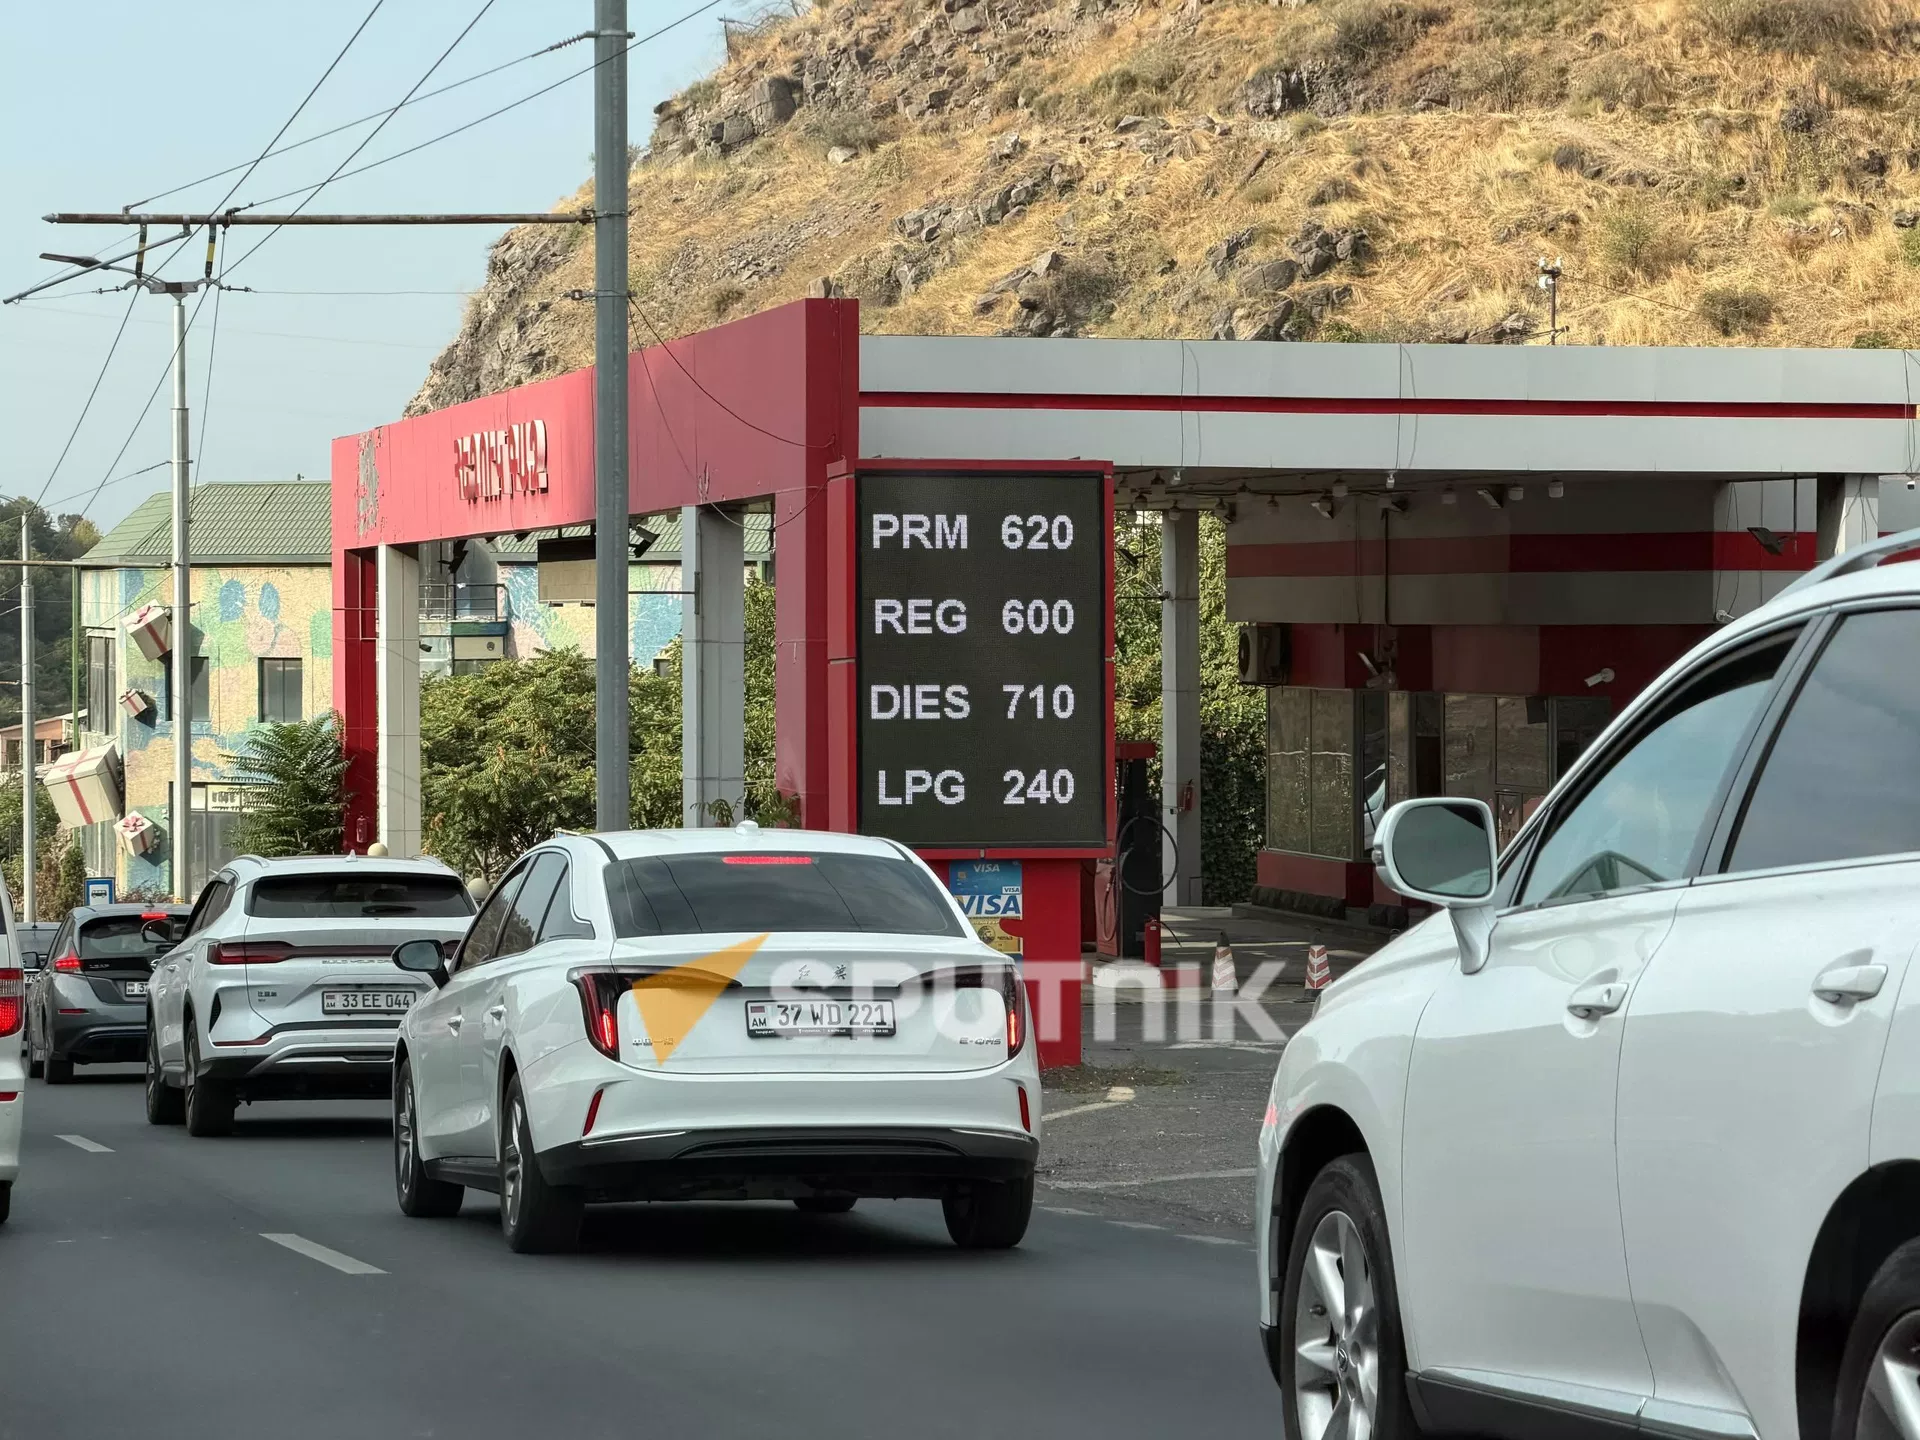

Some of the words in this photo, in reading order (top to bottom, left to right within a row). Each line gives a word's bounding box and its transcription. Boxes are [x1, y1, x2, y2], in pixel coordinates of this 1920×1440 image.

[873, 514, 967, 549] PRM
[1002, 515, 1073, 549] 620
[875, 599, 966, 634] REG
[1002, 599, 1074, 634] 600
[871, 684, 970, 719] DIES
[1003, 684, 1074, 719] 710
[878, 769, 965, 805] LPG
[1003, 769, 1074, 804] 240
[973, 863, 1000, 873] VISA
[960, 895, 1021, 915] VISA
[342, 994, 358, 1008] 33
[362, 994, 381, 1008] EE
[386, 994, 410, 1008] 044
[752, 1017, 767, 1027] AM
[777, 1004, 802, 1026] 37
[810, 1004, 841, 1026] WD
[848, 1004, 887, 1026] 221
